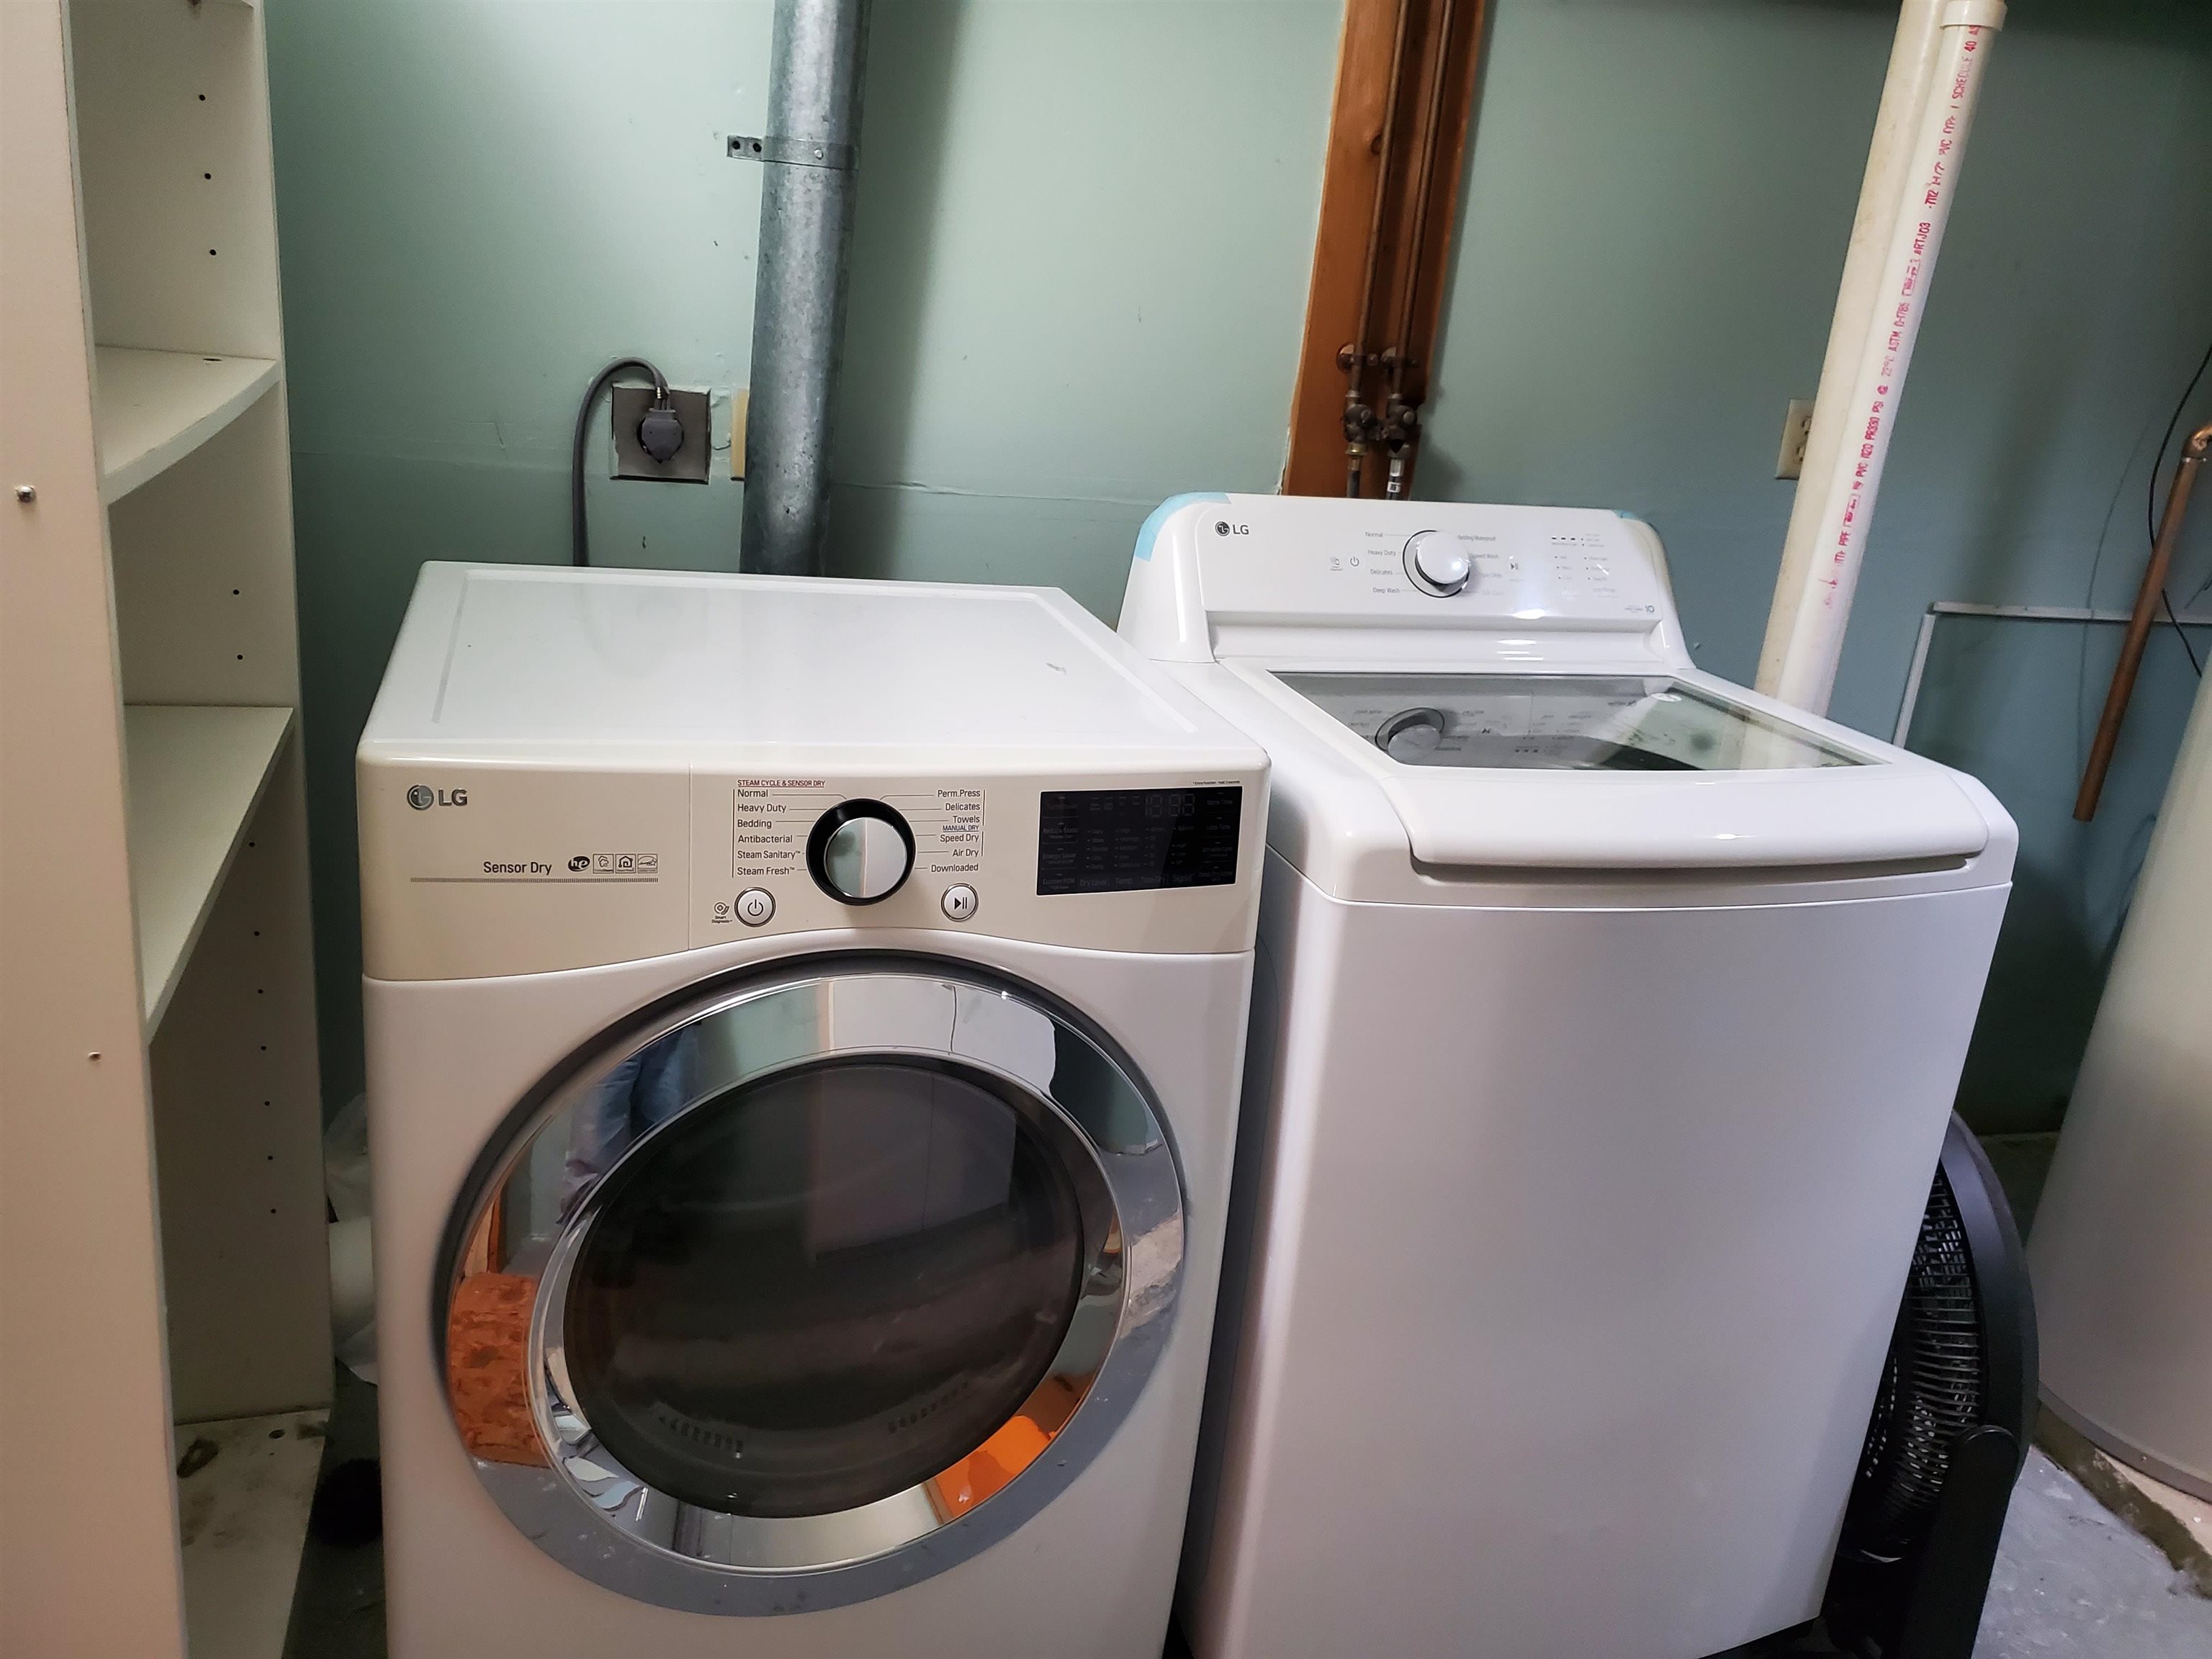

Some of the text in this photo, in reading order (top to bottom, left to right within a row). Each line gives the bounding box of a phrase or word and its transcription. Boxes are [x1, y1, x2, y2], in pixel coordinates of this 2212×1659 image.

[1965, 41, 1977, 51] 40
[1232, 524, 1249, 535] LG
[439, 789, 467, 806] LG
[737, 804, 786, 813] Heavy Duty
[737, 819, 772, 829] Bedding
[737, 835, 793, 843] Antibacterial
[940, 833, 979, 843] Speed Dry
[737, 850, 762, 859] Steam
[966, 849, 979, 858] Dry
[483, 861, 552, 876] Sensor Dry
[737, 867, 764, 876] Steam
[931, 863, 979, 872] Downloaded
